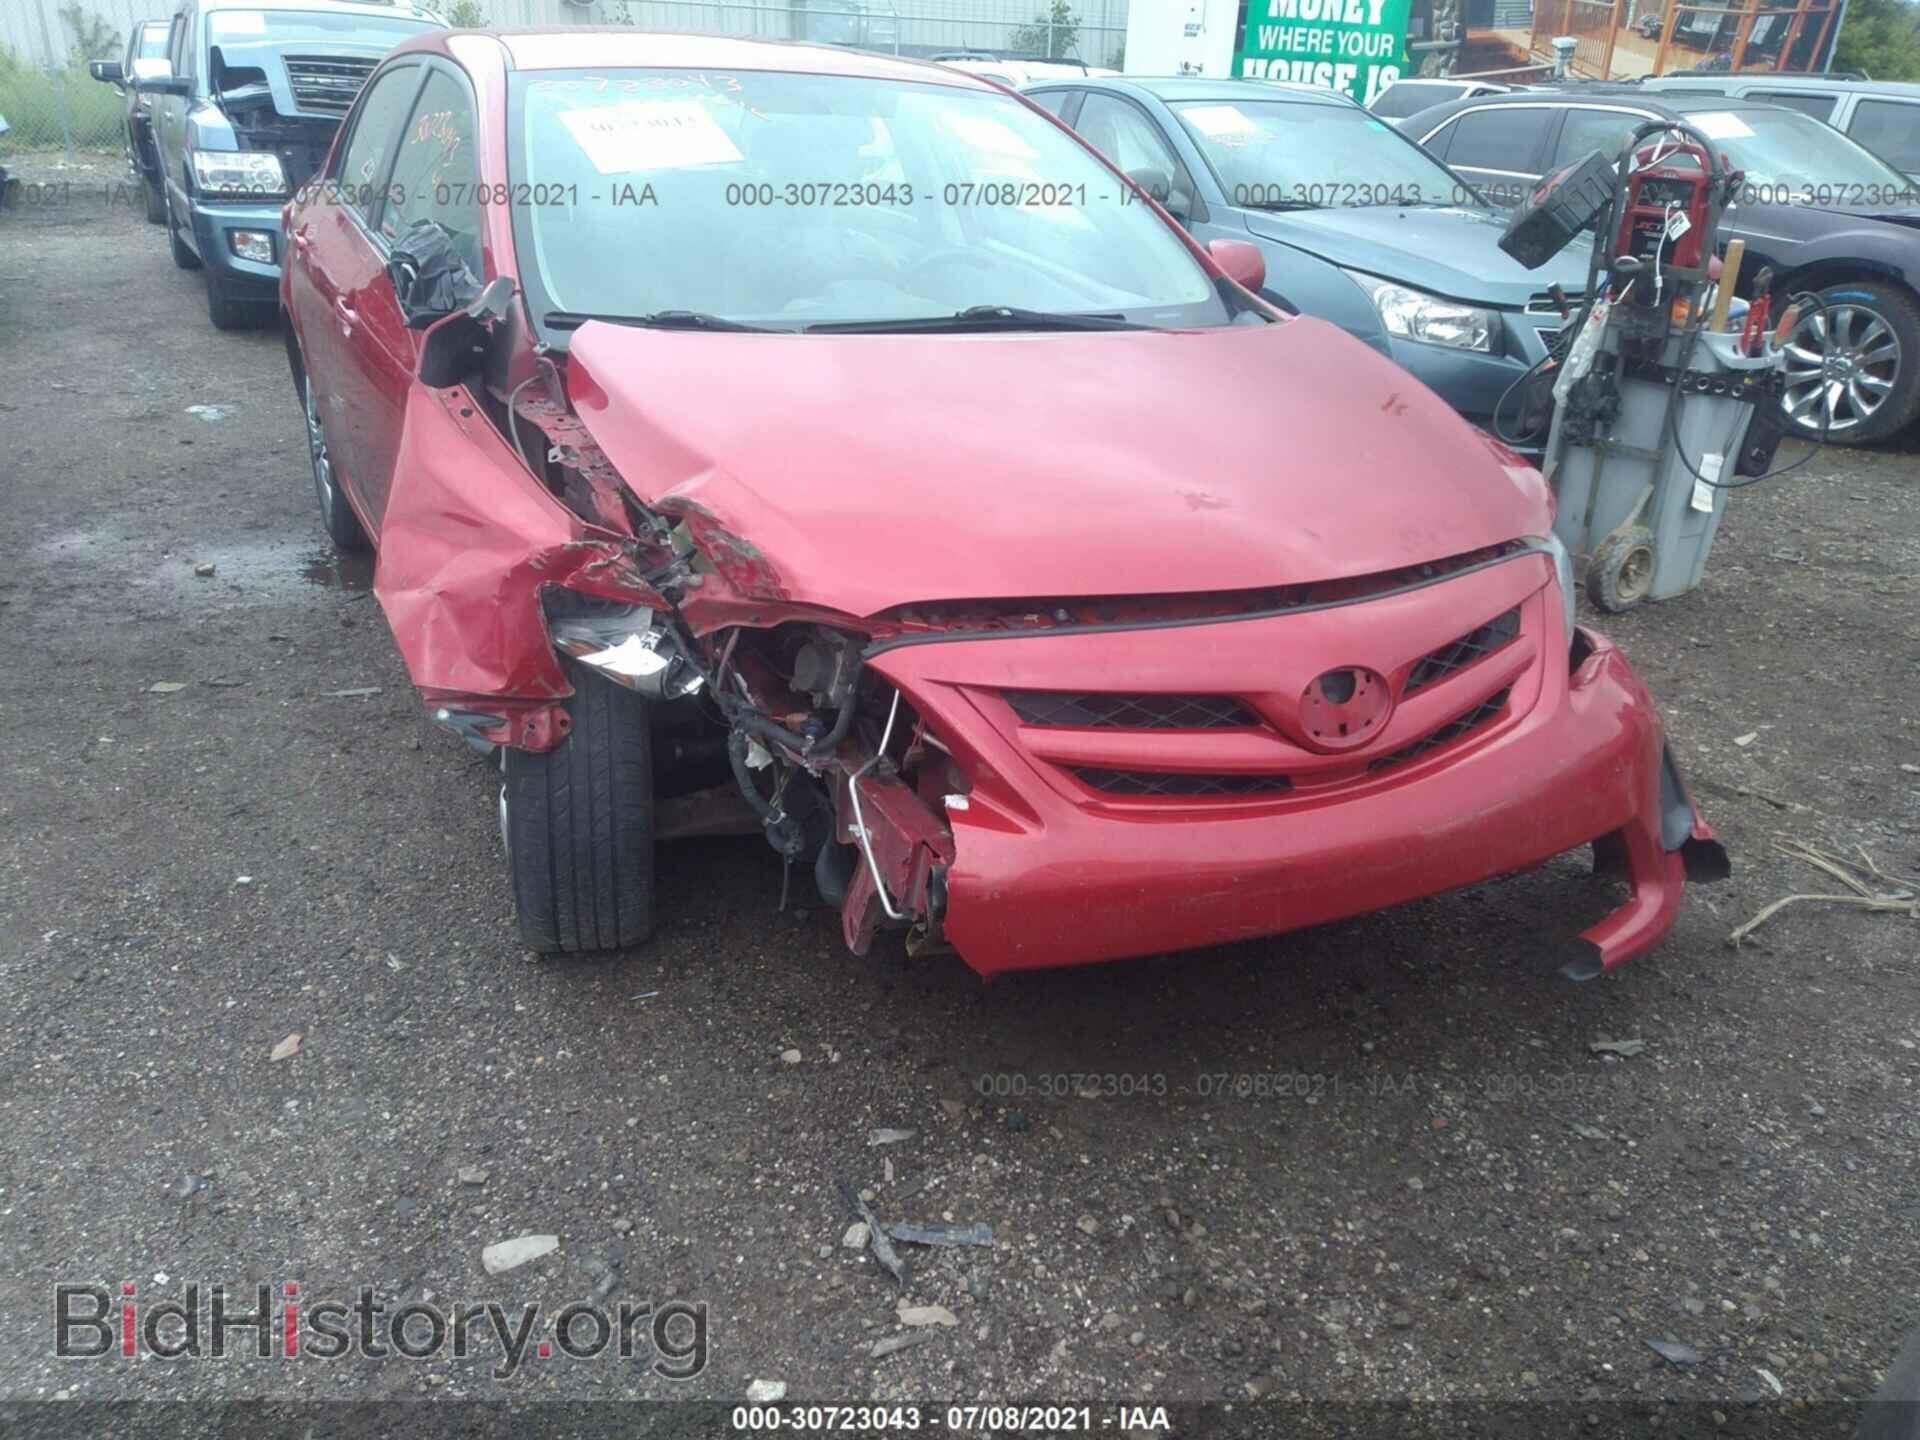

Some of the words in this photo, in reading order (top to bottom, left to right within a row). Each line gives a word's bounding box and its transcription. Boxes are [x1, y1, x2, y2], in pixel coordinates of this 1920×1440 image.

[1267, 0, 1386, 25] MONEY
[1258, 24, 1334, 54] WHERE
[1337, 30, 1395, 57] YOUR
[1242, 58, 1357, 98] HOUSE
